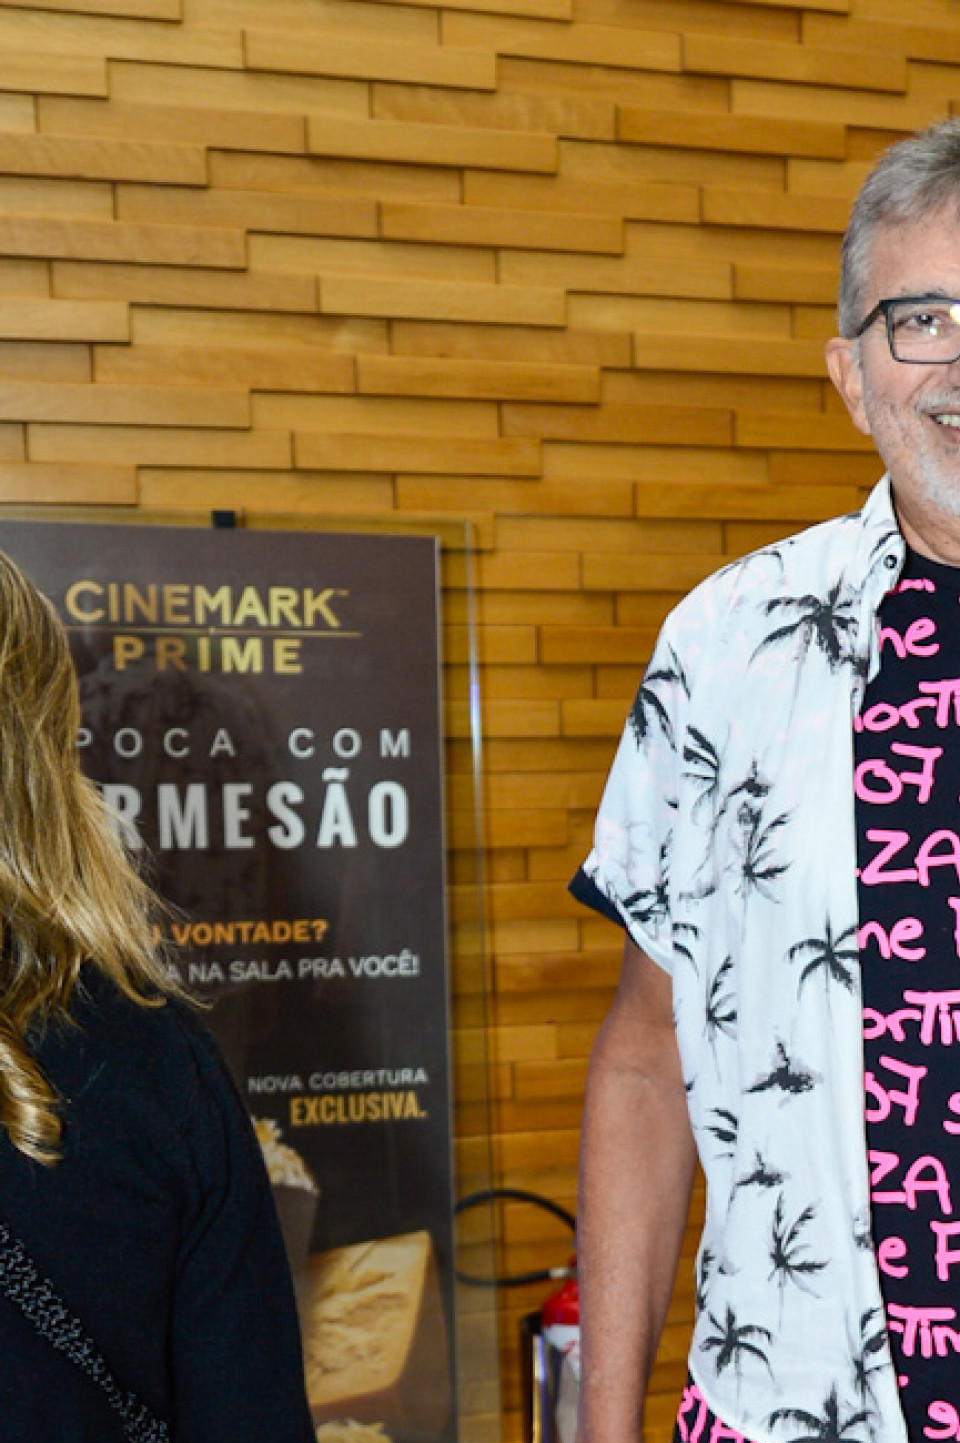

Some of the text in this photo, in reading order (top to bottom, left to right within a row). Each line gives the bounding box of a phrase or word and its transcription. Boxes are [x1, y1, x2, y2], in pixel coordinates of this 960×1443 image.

[65, 580, 341, 628] CINEMARK
[112, 634, 304, 674] PRIME
[288, 727, 411, 758] COM
[170, 919, 328, 946] VONTADE?
[188, 961, 224, 983] NA
[229, 958, 292, 982] SALA
[298, 957, 345, 978] PRA
[348, 948, 419, 978] VOCÊ!
[248, 1067, 428, 1093] NOVA COBERTURA
[290, 1091, 428, 1126] EXCLUSIVA.
